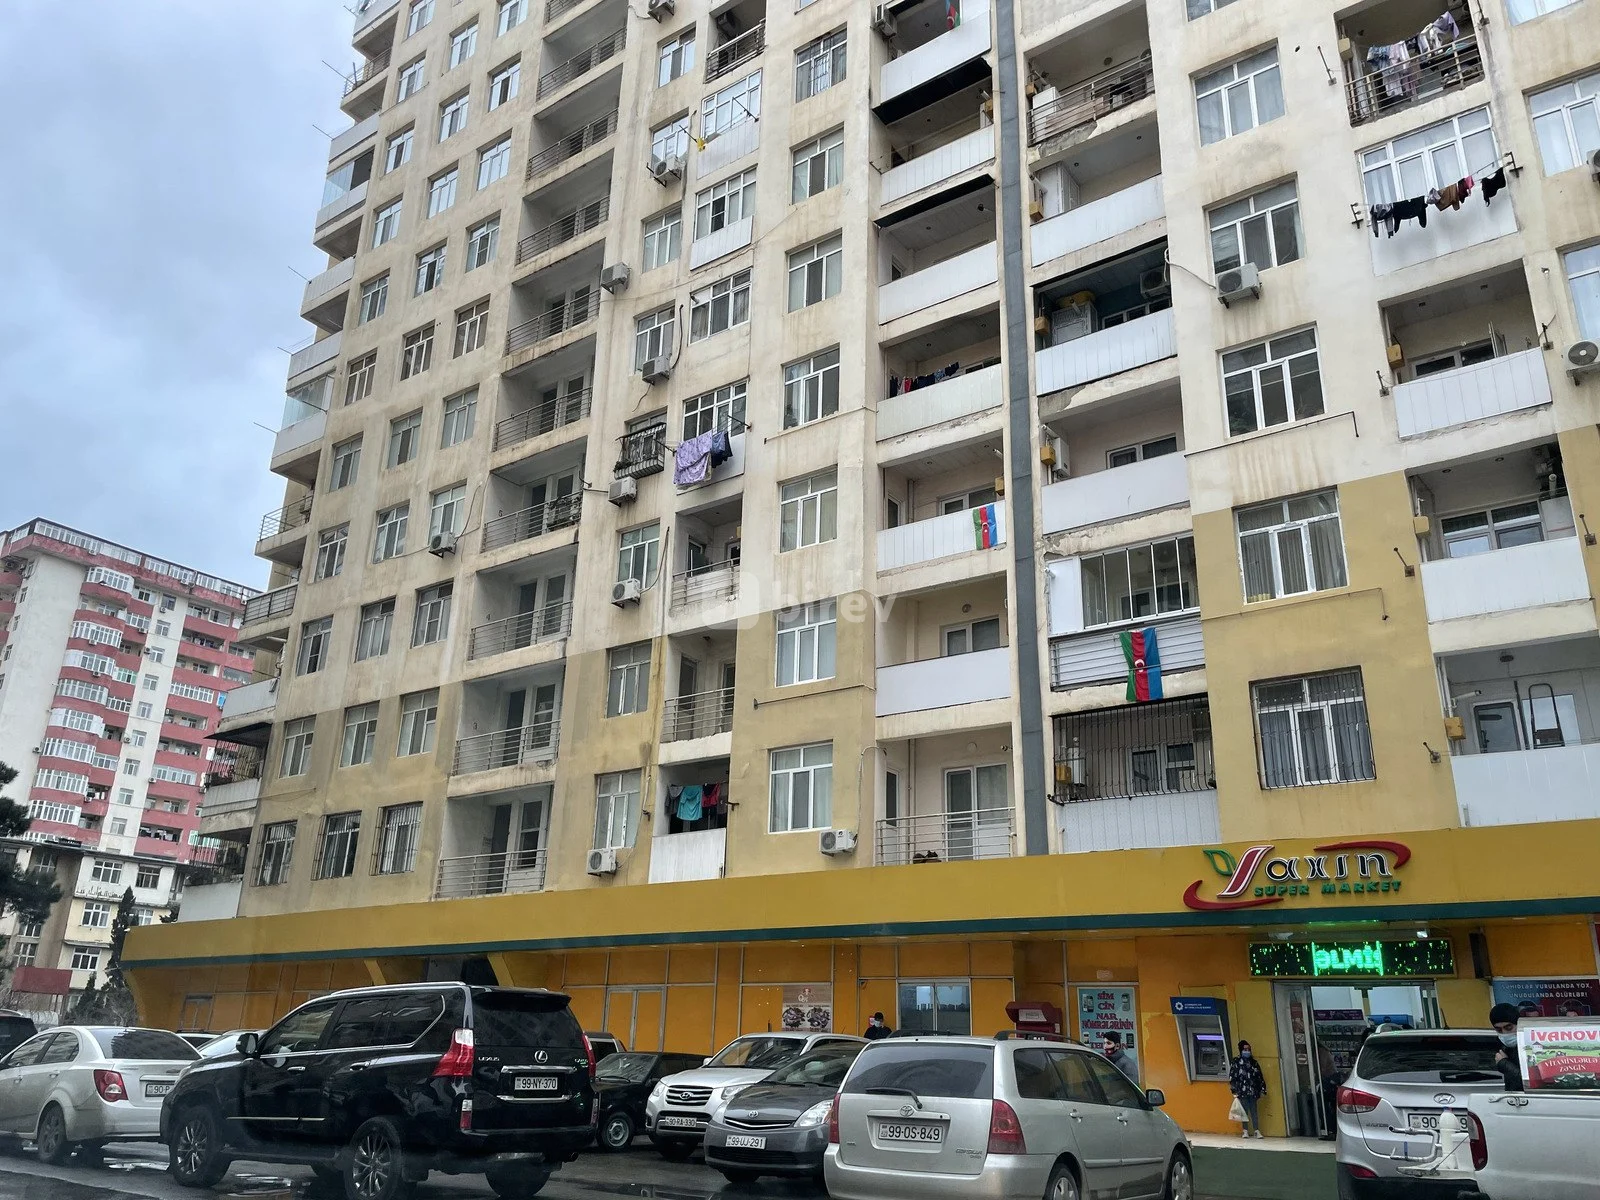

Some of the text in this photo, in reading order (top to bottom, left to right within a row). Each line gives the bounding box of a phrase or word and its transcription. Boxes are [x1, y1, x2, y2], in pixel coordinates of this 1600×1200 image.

[1254, 880, 1402, 897] SUPER MARKET
[1096, 1012, 1118, 1020] NAR
[1530, 1029, 1600, 1041] İVANOV
[521, 1078, 557, 1089] 99-NY-370
